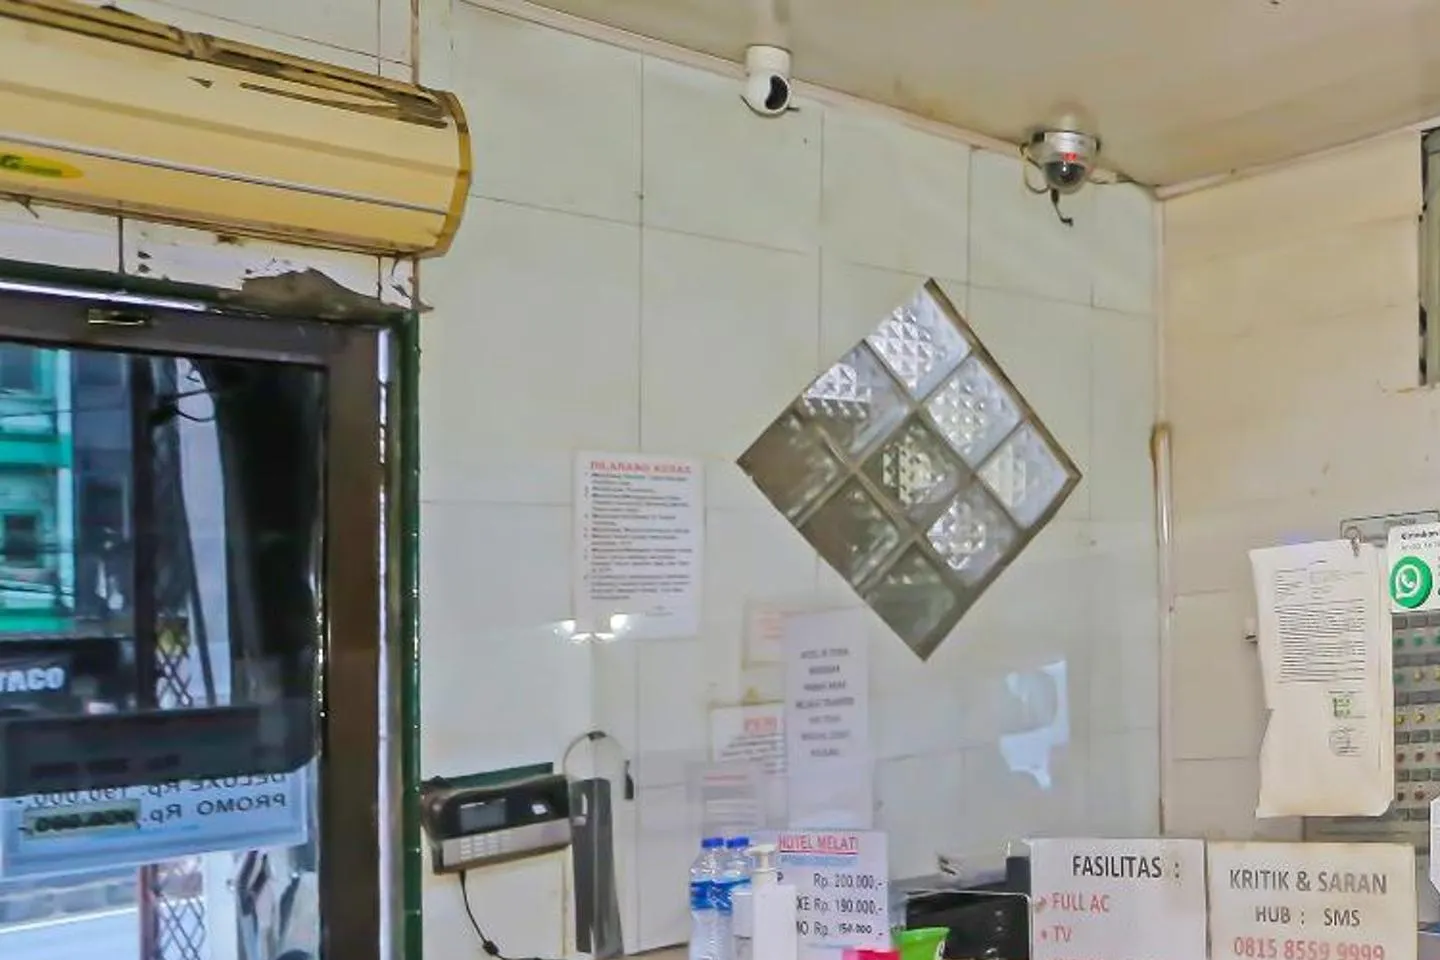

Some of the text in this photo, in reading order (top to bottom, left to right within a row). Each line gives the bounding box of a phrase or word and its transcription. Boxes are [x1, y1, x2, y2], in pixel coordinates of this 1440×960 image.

[779, 834, 813, 850] HOTEL
[1072, 855, 1163, 879] FASILITAS
[1229, 869, 1387, 894] KRITIK & SARAN
[1051, 892, 1111, 913] FULL AC
[1255, 905, 1292, 924] HUB
[1323, 907, 1361, 927] SMS
[1053, 925, 1072, 943] TV
[1233, 936, 1278, 959] 0815
